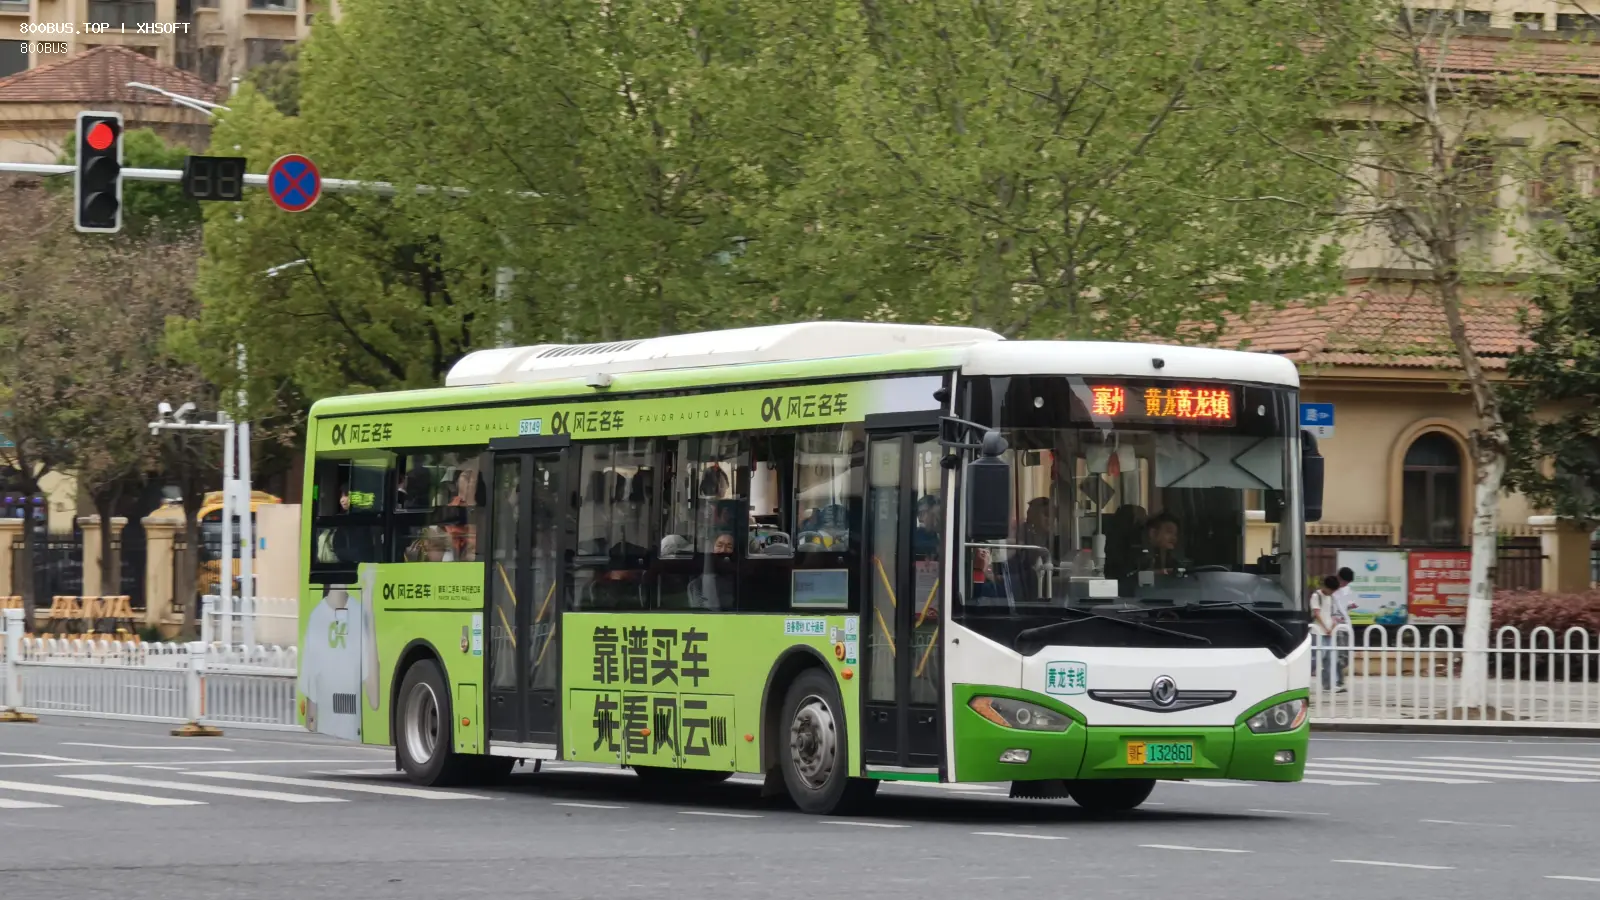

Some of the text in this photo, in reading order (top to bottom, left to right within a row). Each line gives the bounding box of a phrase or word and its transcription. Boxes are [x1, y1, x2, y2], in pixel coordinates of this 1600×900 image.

[639, 407, 745, 422] FAVOR AUTO MALL
[786, 393, 848, 419] 风云名车
[520, 420, 540, 433] 58149
[573, 410, 625, 433] 风云名车
[350, 423, 393, 443] 风云名车
[397, 583, 432, 600] 风云名车
[593, 625, 709, 687] 靠谱买车
[1048, 668, 1085, 688] 黄龙专线
[593, 694, 711, 756] 先看风云
